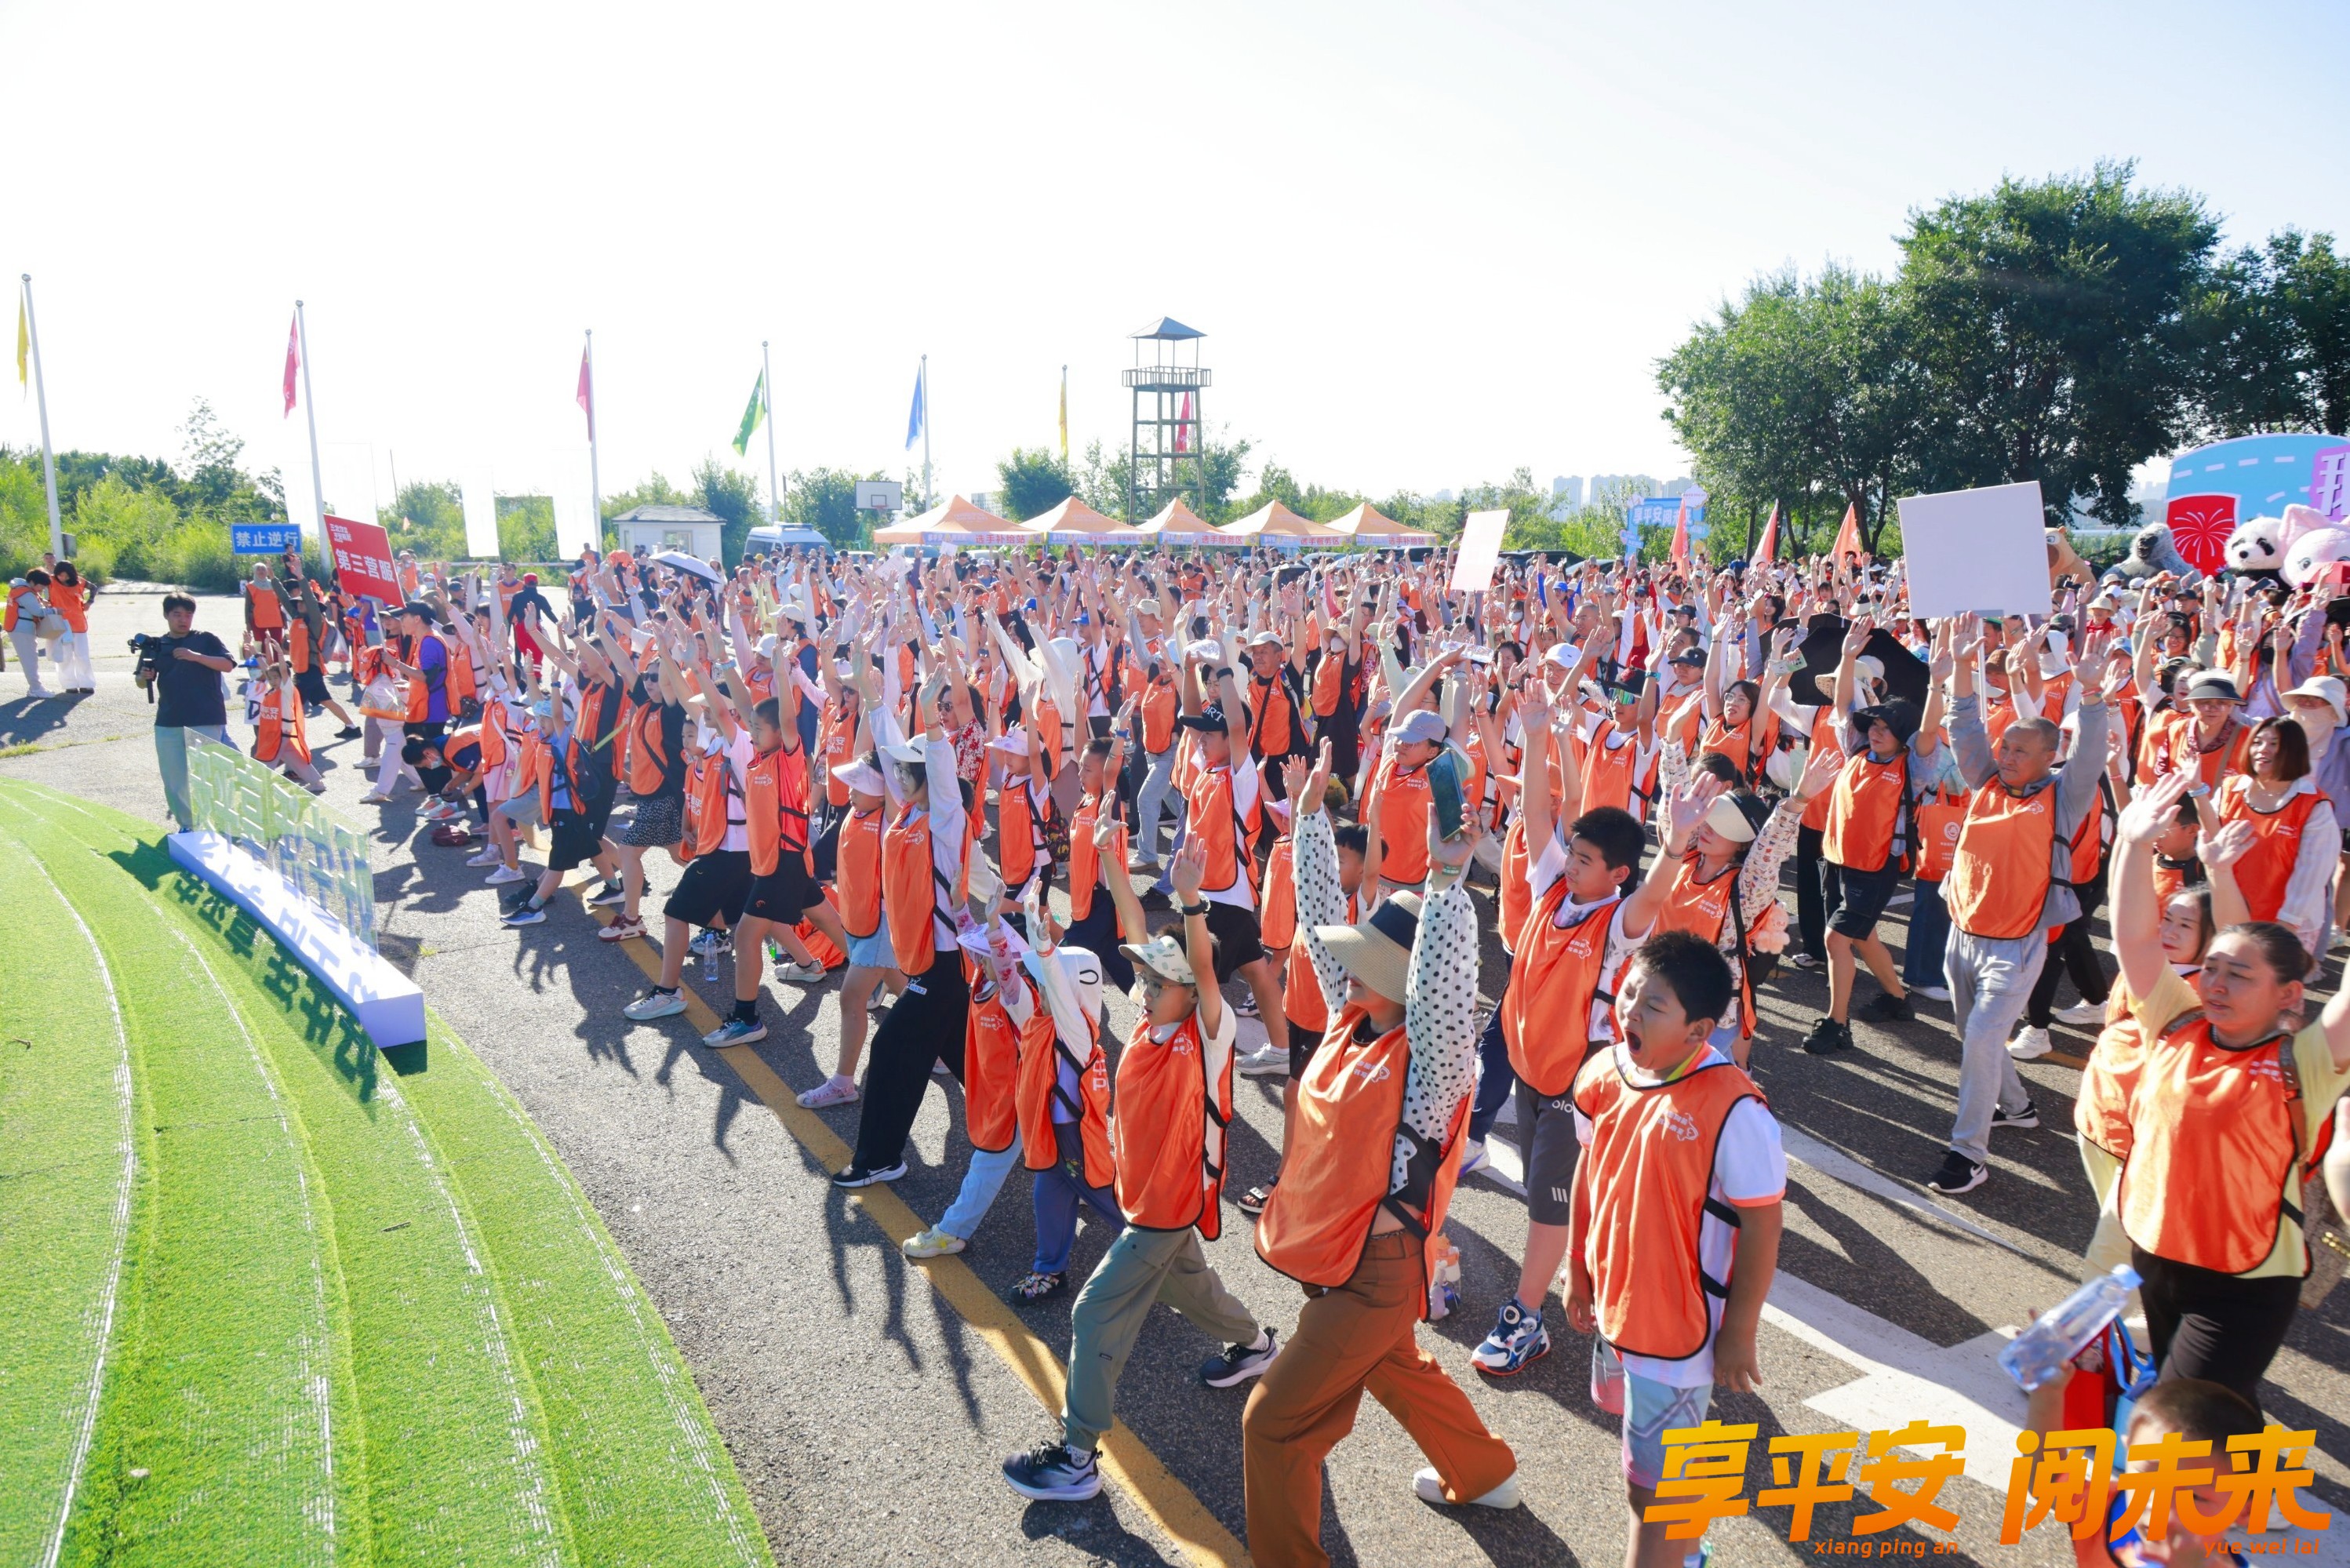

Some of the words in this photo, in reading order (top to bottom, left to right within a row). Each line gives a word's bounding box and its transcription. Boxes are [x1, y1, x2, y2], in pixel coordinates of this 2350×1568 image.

[235, 531, 298, 548] 禁止逆行
[975, 533, 1025, 544] 选手补给站
[1202, 534, 1243, 545] 选手服务区
[336, 548, 395, 582] 第三营服
